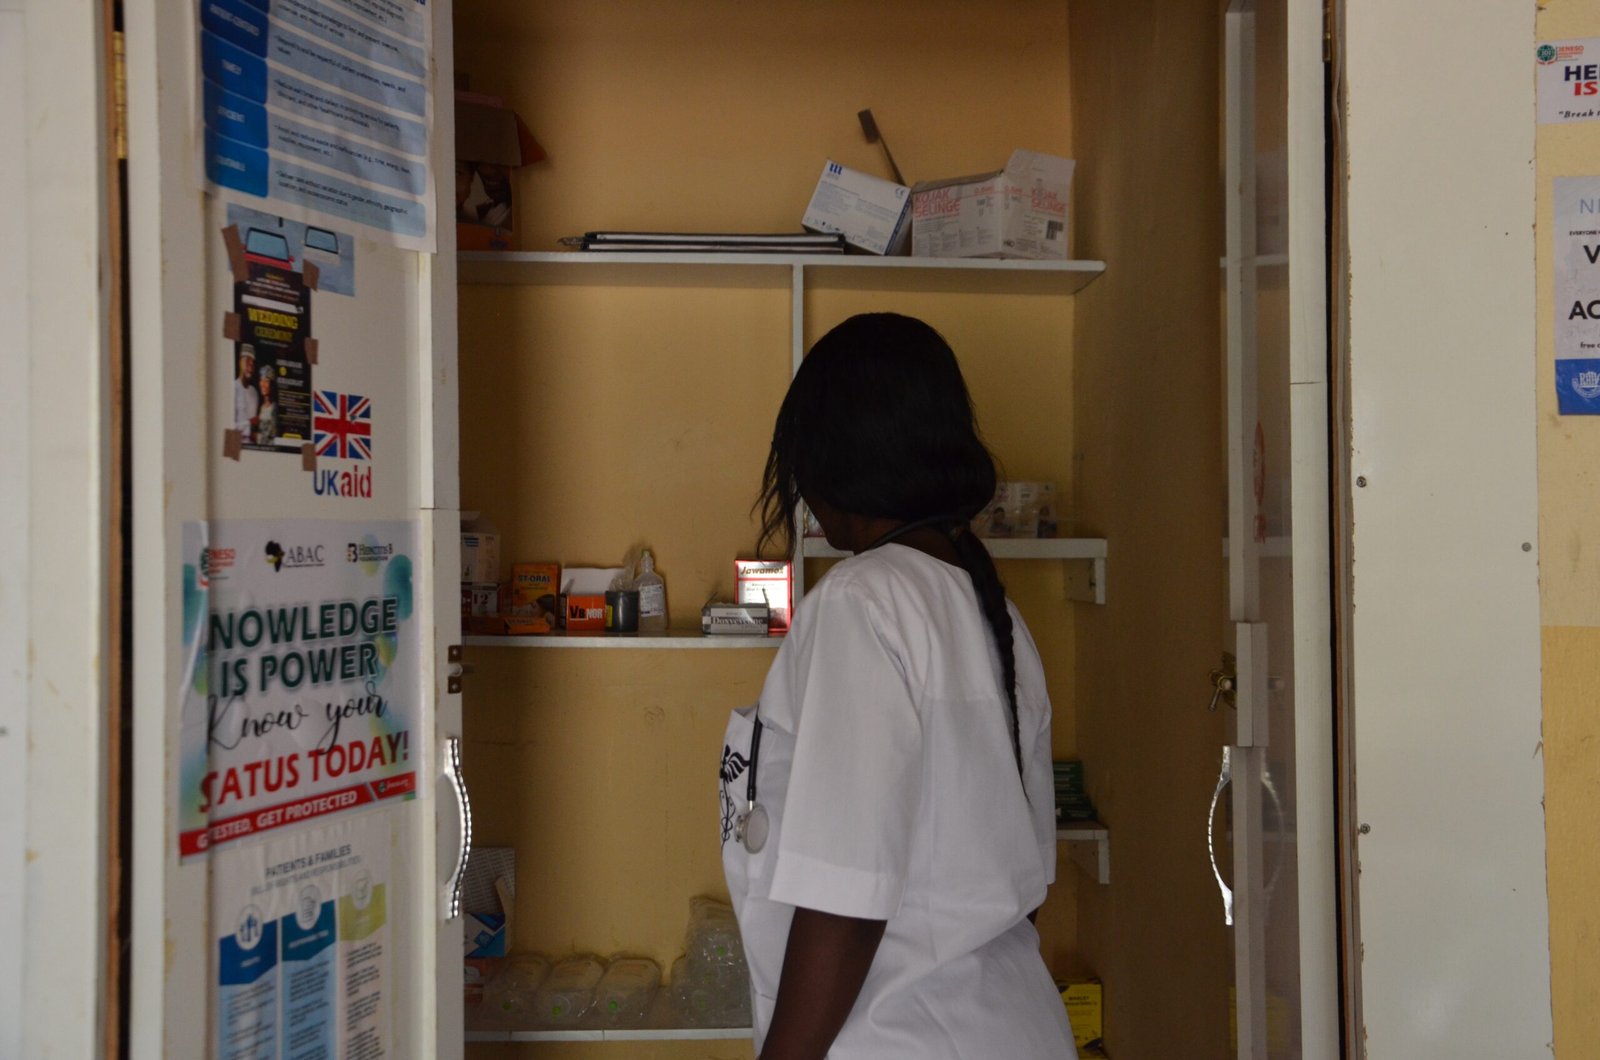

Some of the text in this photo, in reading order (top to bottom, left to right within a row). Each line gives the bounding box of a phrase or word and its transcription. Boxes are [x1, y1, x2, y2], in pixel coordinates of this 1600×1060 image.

[1564, 64, 1600, 81] HE
[1574, 81, 1598, 96] IS
[1580, 198, 1600, 214] N
[1580, 341, 1595, 349] free
[288, 545, 325, 563] ABAC
[221, 643, 378, 698] IS POWER
[317, 680, 388, 756] your
[308, 730, 409, 783] TODAY!
[256, 806, 285, 828] GET
[286, 790, 359, 820] PROTECTED
[265, 858, 307, 880] PATIENTS
[315, 844, 352, 864] FAMILIES
